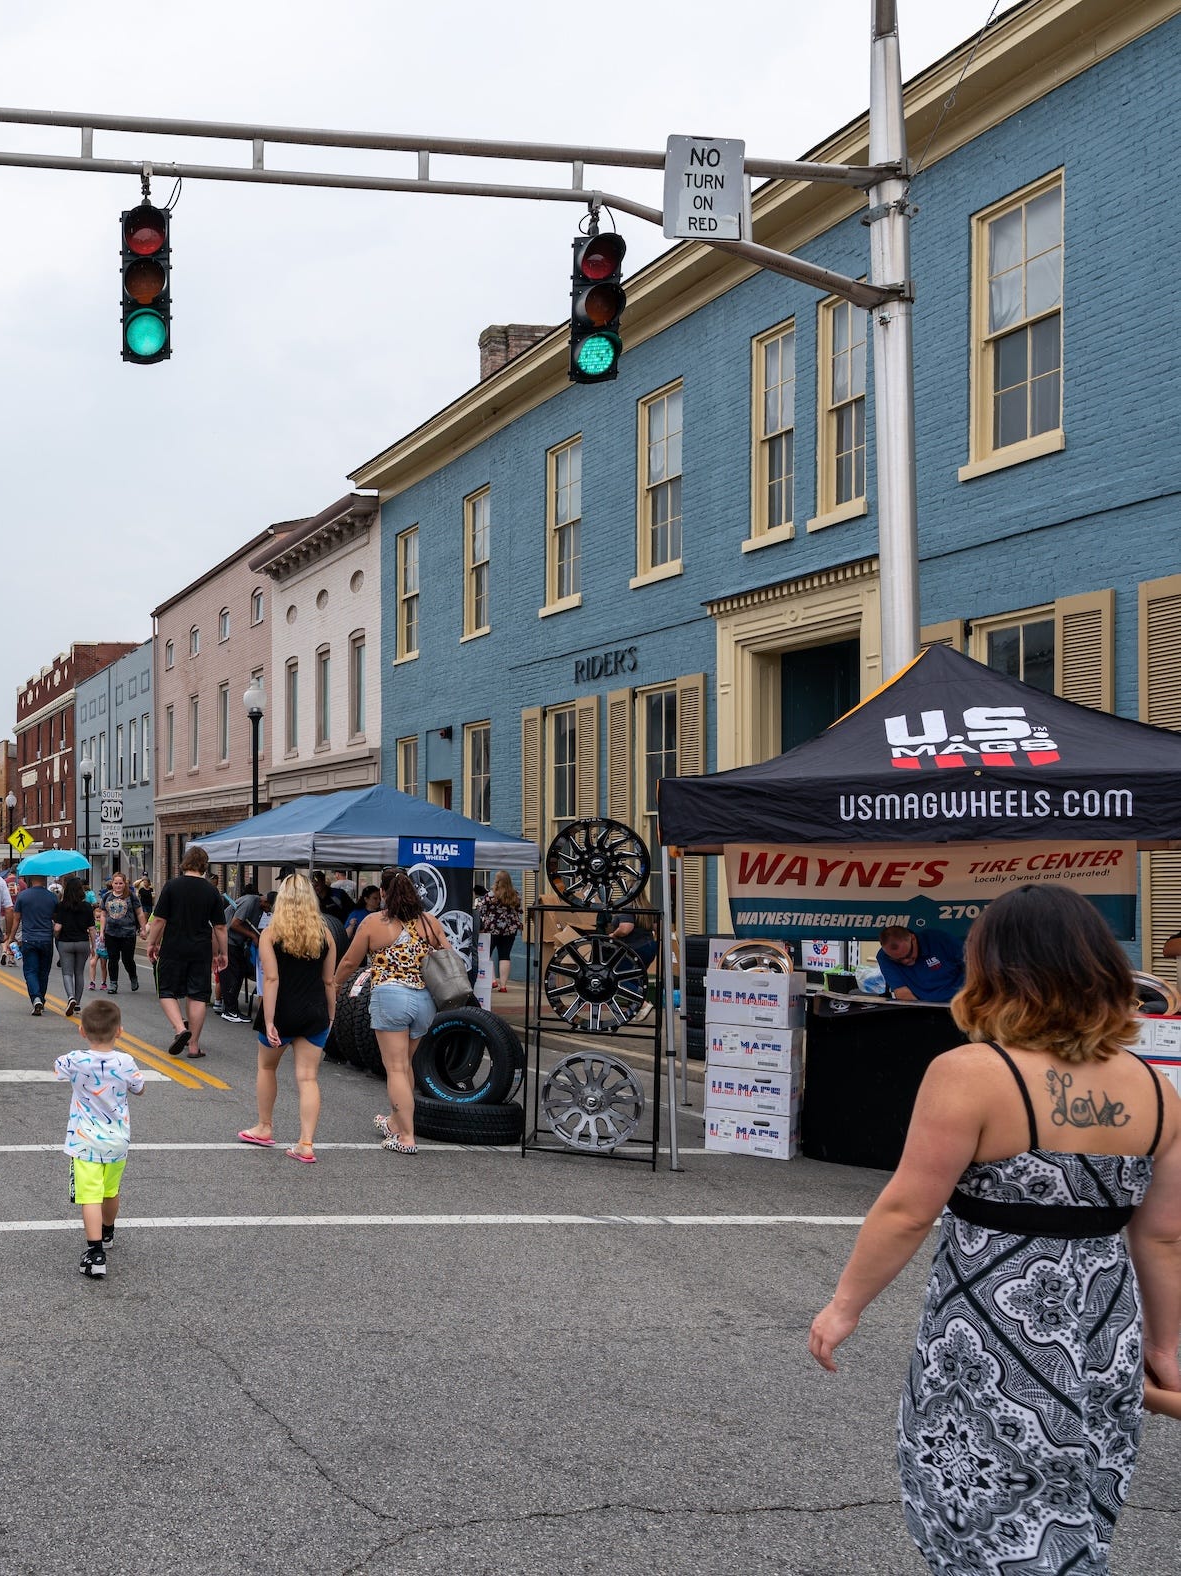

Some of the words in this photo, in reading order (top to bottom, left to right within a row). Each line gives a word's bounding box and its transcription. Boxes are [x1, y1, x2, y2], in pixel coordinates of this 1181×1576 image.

[690, 147, 721, 167] NO
[684, 173, 724, 190] TURN
[693, 195, 713, 211] ON
[688, 216, 718, 231] RED
[574, 646, 637, 684] RIDER'S
[884, 706, 1049, 746] U.S.
[891, 739, 1059, 758] MAGS
[103, 806, 121, 818] 31W
[839, 789, 1134, 821] USMAGWHEELS.COM
[103, 837, 120, 848] 25
[738, 851, 950, 888] WAYNE'S
[968, 857, 1023, 874] TIRE
[1026, 849, 1124, 871] CENTER
[974, 874, 1007, 884] Locally
[1009, 872, 1041, 882] Owned
[1043, 871, 1061, 880] and
[1063, 869, 1110, 880] Operated!
[736, 911, 911, 928] WAYNESTIRECENTER.COM
[431, 1020, 467, 1036] RADIAL
[425, 1076, 453, 1101] COBRA
[456, 1082, 491, 1103] COOPER
[1046, 1065, 1131, 1128] Love
